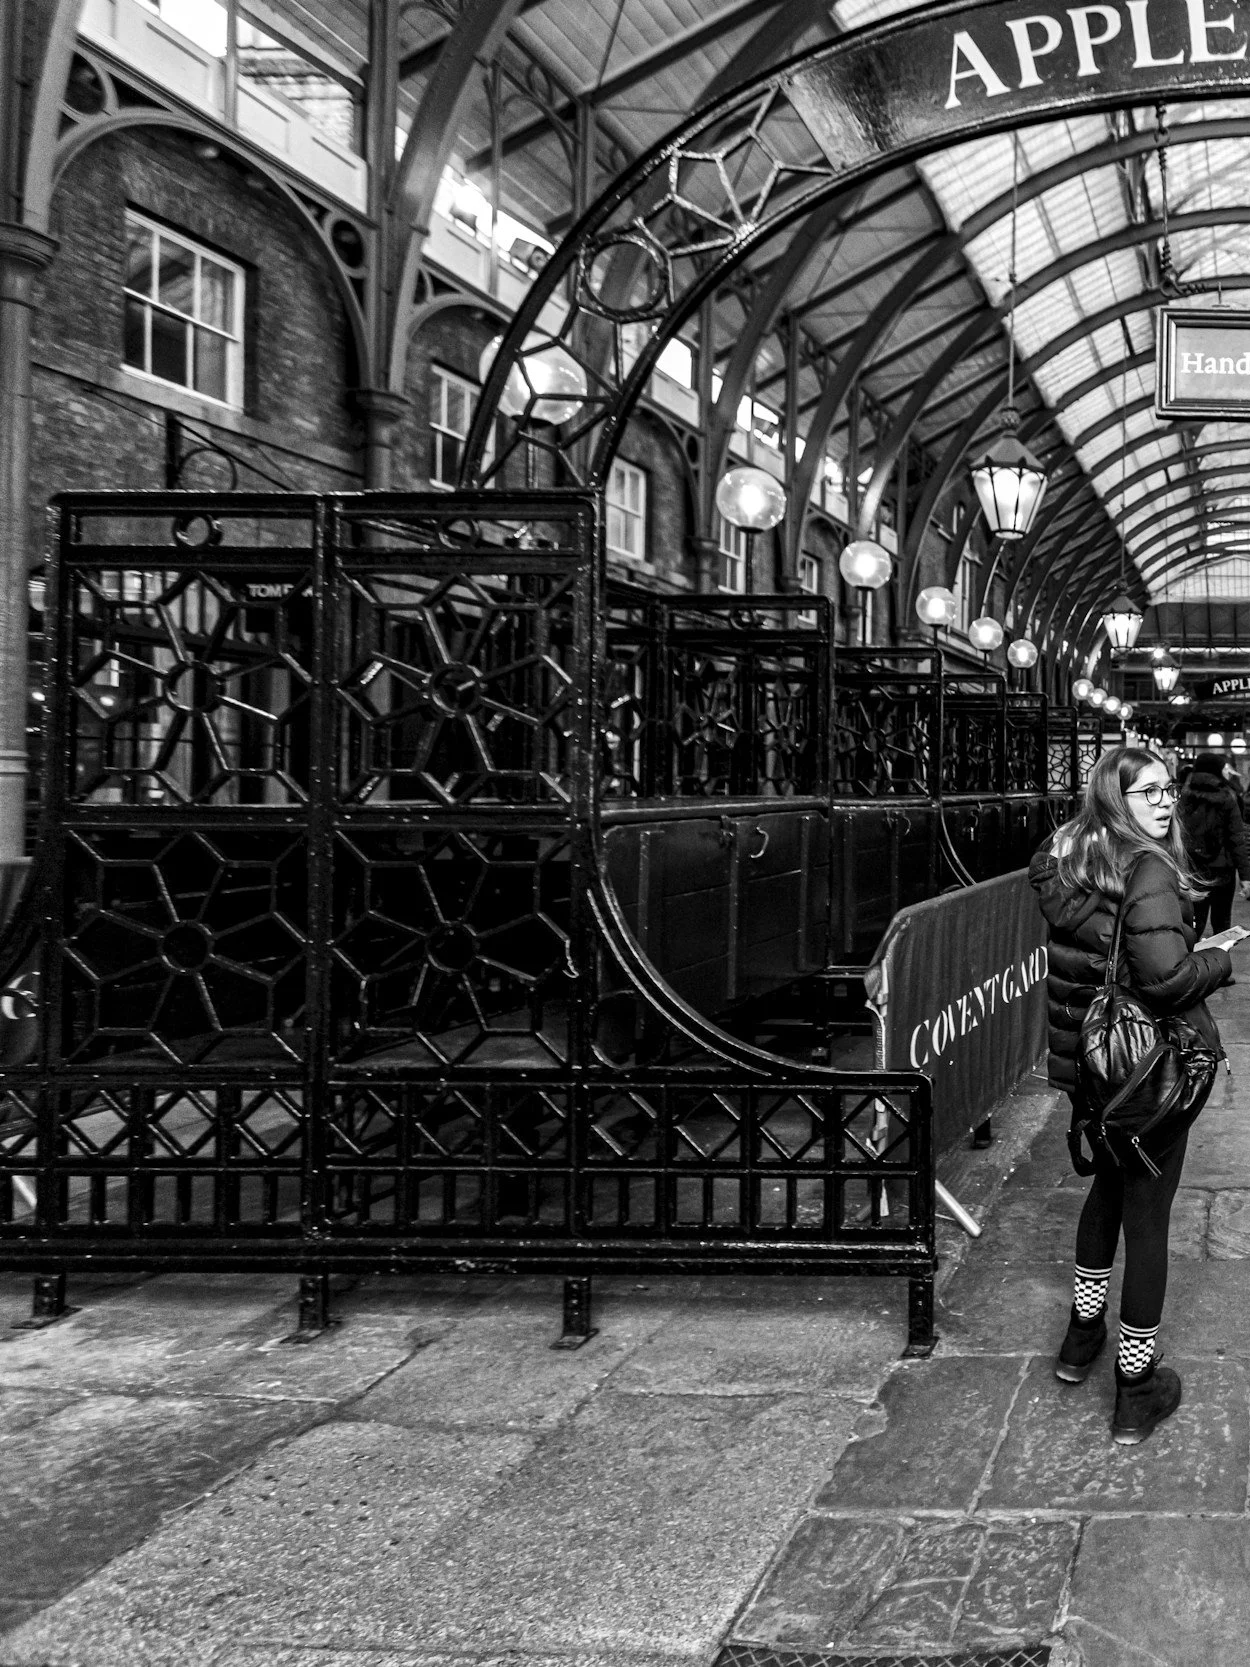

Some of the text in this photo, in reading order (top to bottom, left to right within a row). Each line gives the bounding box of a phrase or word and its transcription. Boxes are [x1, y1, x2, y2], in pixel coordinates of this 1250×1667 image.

[944, 0, 1248, 110] APPLE
[246, 583, 282, 598] TOM
[910, 945, 1049, 1069] COVENT GARD
